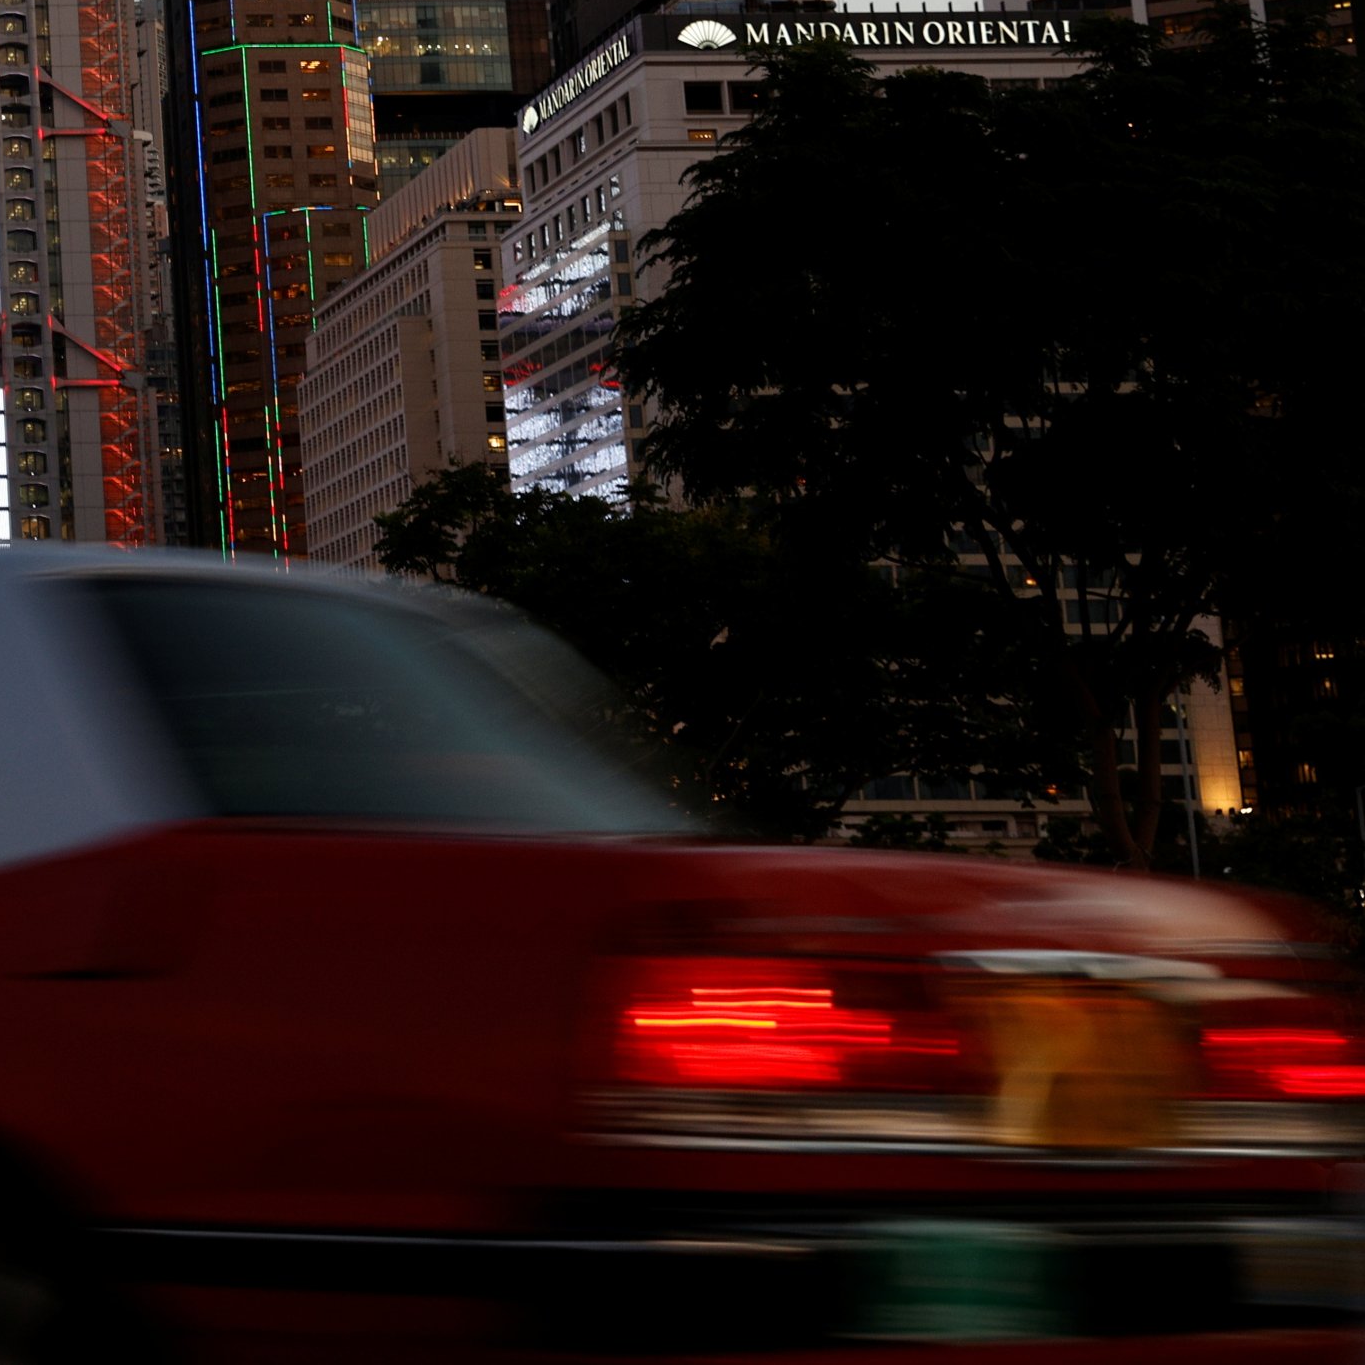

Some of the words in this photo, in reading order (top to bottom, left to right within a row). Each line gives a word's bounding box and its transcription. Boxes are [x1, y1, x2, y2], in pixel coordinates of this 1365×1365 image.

[745, 22, 915, 46] MANDARIN
[539, 69, 586, 123] MANDARIN
[584, 35, 630, 87] ORIENTAL
